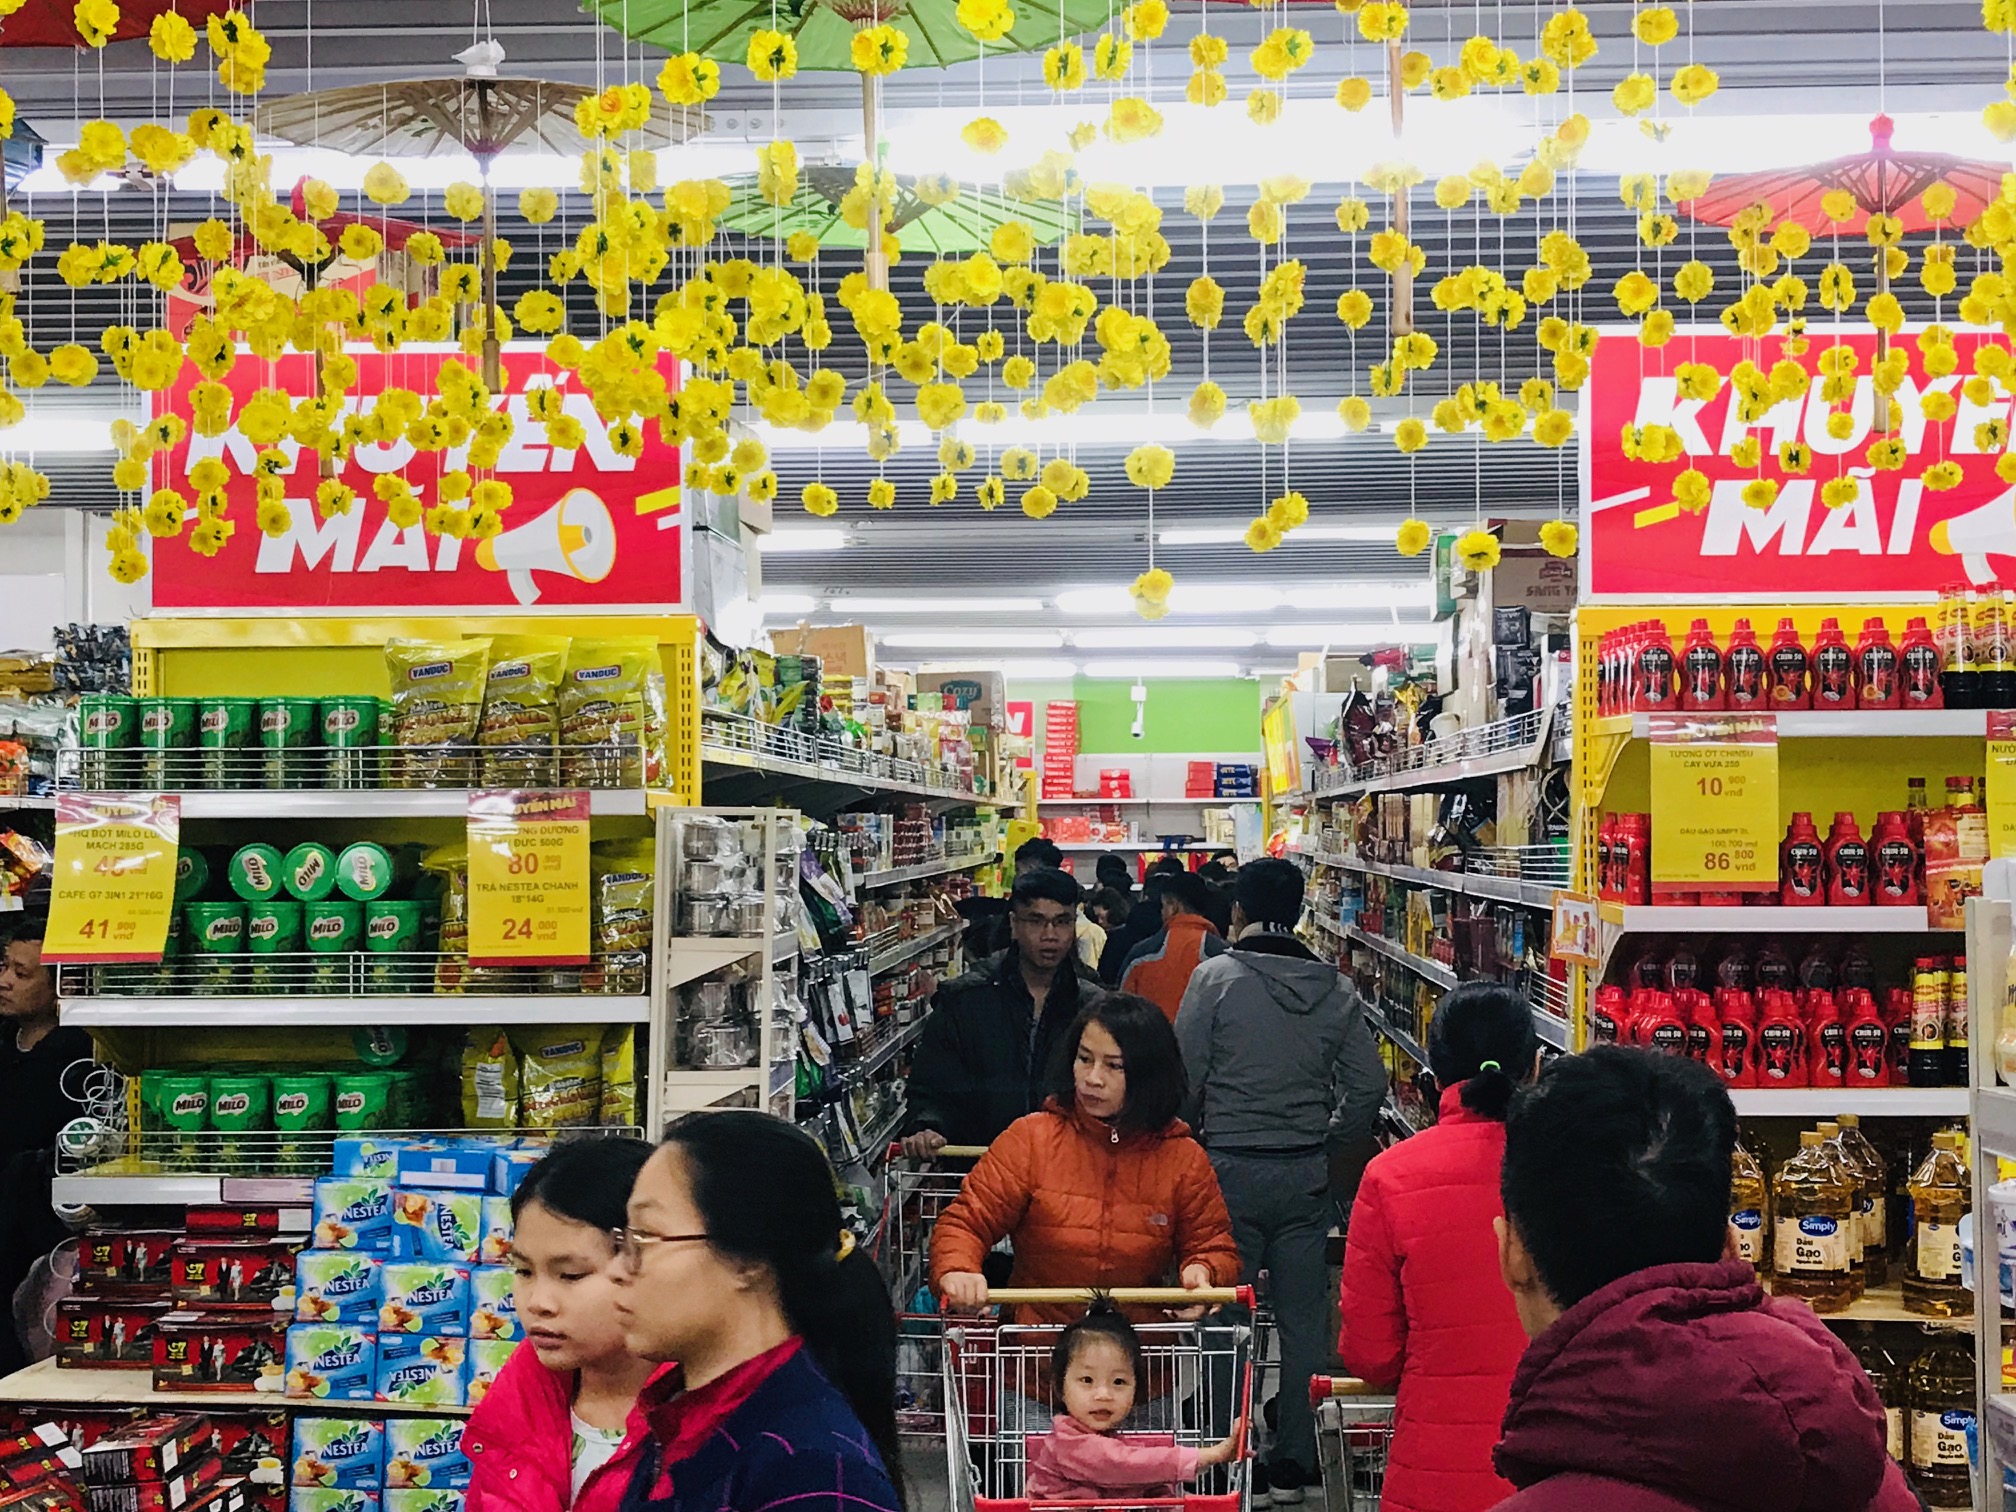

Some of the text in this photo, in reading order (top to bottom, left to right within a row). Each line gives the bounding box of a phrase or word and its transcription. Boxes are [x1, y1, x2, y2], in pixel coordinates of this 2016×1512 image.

[1700, 466, 1923, 556] MÃI
[1776, 652, 1802, 660] CHIN-SU
[413, 664, 449, 678] VANDUC
[579, 668, 617, 679] VANDUC
[943, 681, 978, 699] Cozy
[88, 714, 117, 728] MLO
[1696, 777, 1723, 796] 10
[1790, 847, 1818, 856] CHIN-SU
[1839, 847, 1865, 856] CHIN-SU
[1881, 846, 1909, 856] CHIN-SU
[508, 852, 539, 875] 80
[1704, 852, 1730, 871] 86
[248, 856, 265, 886] MILO
[298, 859, 321, 887] MILO
[358, 855, 370, 886] MILO
[499, 881, 540, 892] NESTEA
[542, 880, 579, 891] CHANH
[88, 890, 102, 900] G7
[79, 918, 110, 940] 41
[212, 921, 242, 936] MILO
[251, 922, 276, 934] MILO
[312, 921, 342, 935] MILO
[369, 921, 396, 935] MILO
[501, 917, 533, 940] 24
[1655, 1030, 1682, 1038] CHIN-SU
[1764, 1028, 1791, 1037] CHIN-SU
[1855, 1029, 1881, 1037] CHIN-SU
[175, 1098, 206, 1111] MILO
[217, 1099, 246, 1112] MILO
[278, 1098, 306, 1111] MILO
[337, 1098, 361, 1109] MILO
[342, 1203, 388, 1221] NESTEA
[1735, 1213, 1761, 1226] Simply
[1802, 1219, 1836, 1233] Simply
[440, 1203, 455, 1251] NESTEA
[1796, 1246, 1821, 1260] Gạo
[325, 1276, 370, 1294] NESTEA
[408, 1287, 455, 1305] NESTEA
[316, 1353, 361, 1369] NESTEA
[389, 1366, 437, 1383] NESTEA
[322, 1440, 369, 1456] NESTEA
[415, 1440, 460, 1456] NESTEA
[1937, 1441, 1963, 1455] Gạo
